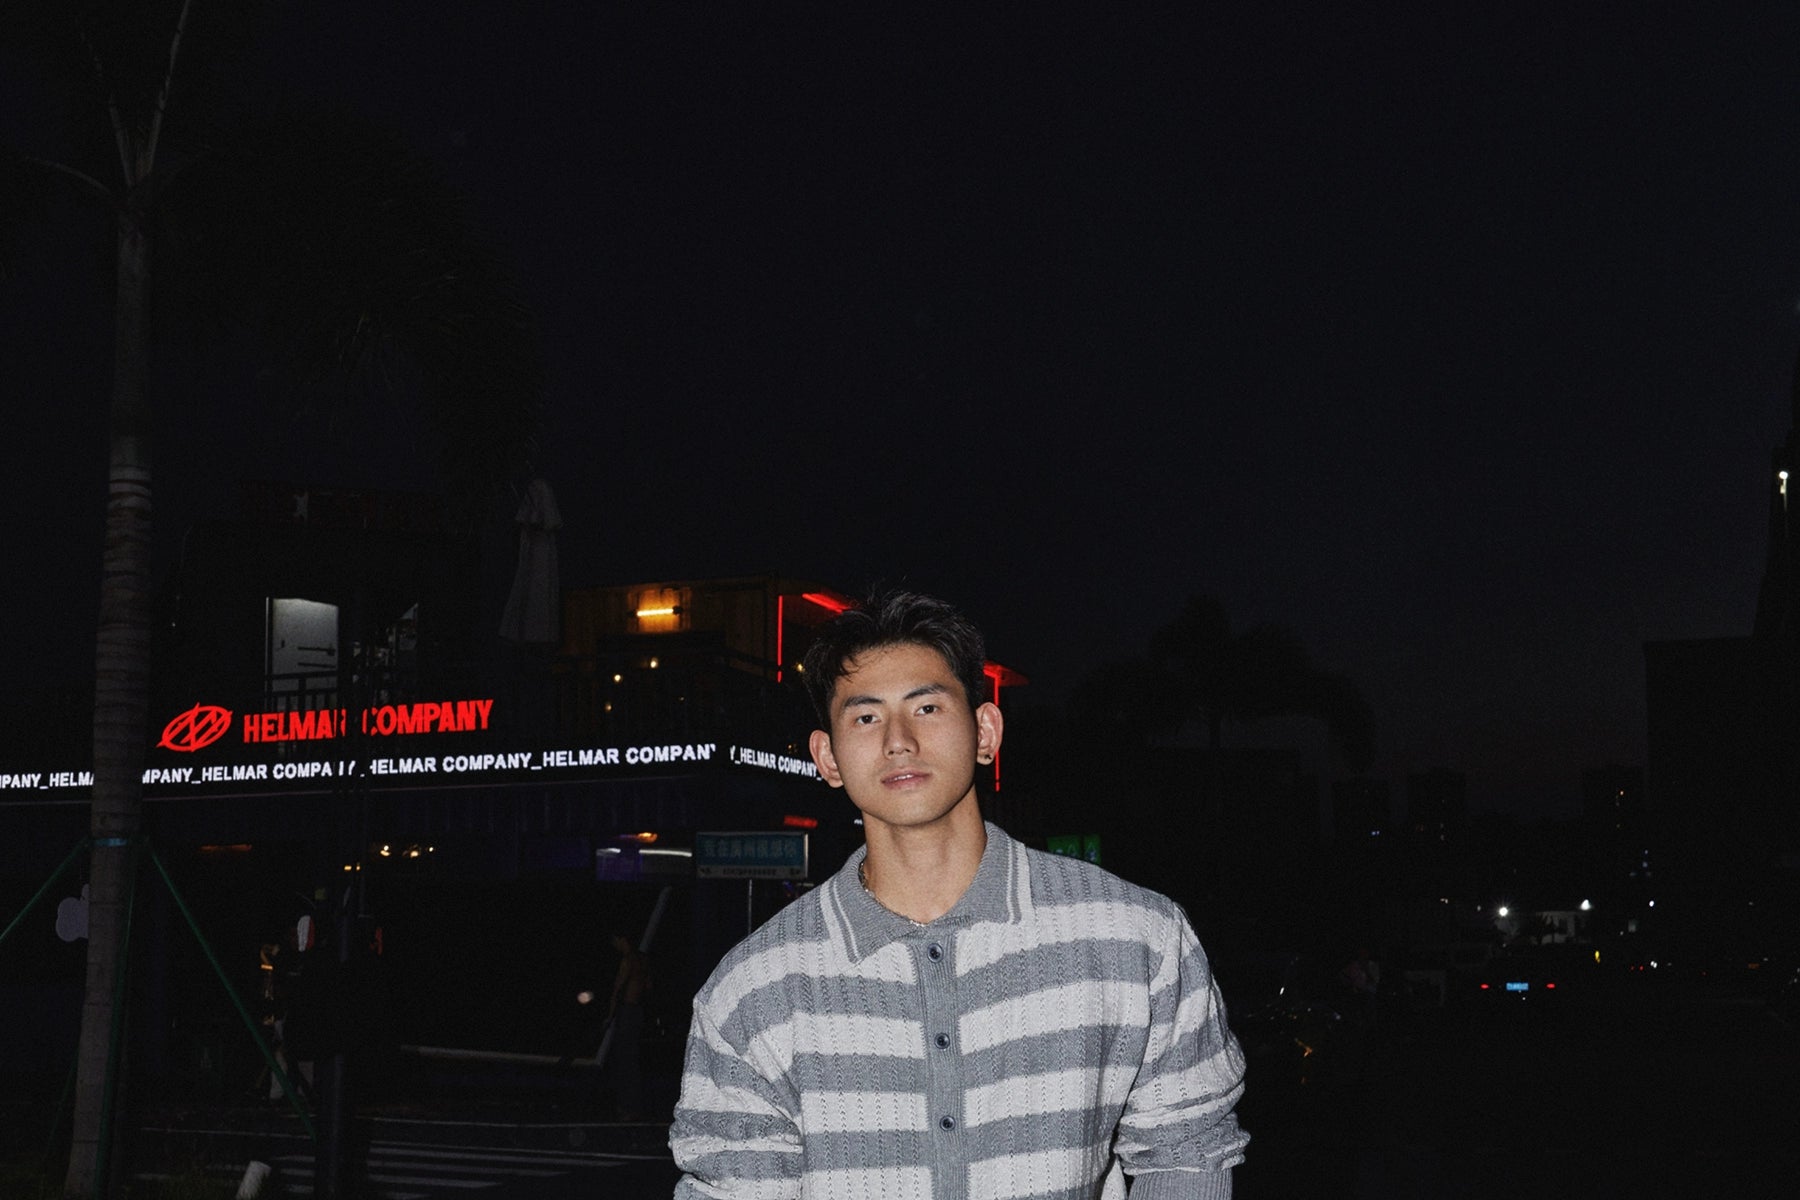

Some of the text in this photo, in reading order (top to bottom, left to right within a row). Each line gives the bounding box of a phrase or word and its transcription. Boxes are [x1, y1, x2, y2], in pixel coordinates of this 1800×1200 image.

[243, 700, 493, 743] HELMAR COMPANY
[0, 772, 94, 789] PANY_HELM
